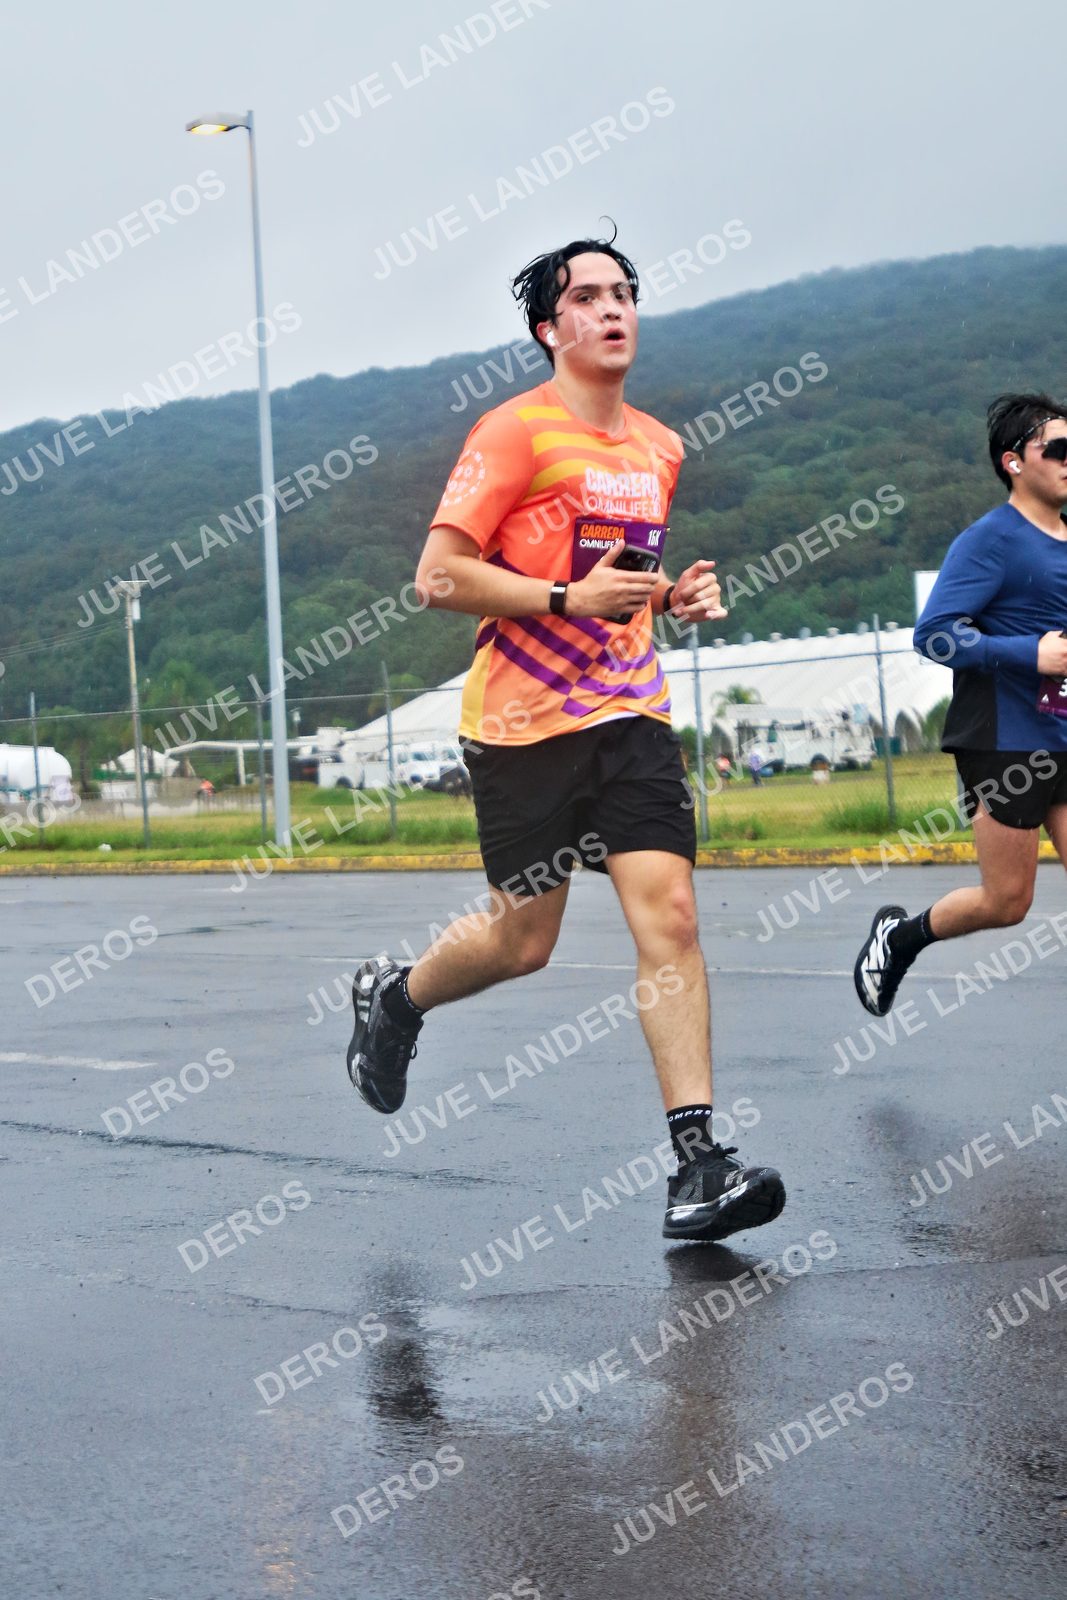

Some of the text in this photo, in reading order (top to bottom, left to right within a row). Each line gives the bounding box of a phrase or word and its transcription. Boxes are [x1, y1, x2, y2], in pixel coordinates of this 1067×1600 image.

[585, 467, 659, 497] CARRERA
[586, 495, 649, 518] OMNILIFE
[580, 523, 625, 540] CARRERA
[579, 538, 615, 550] OMNILIFE
